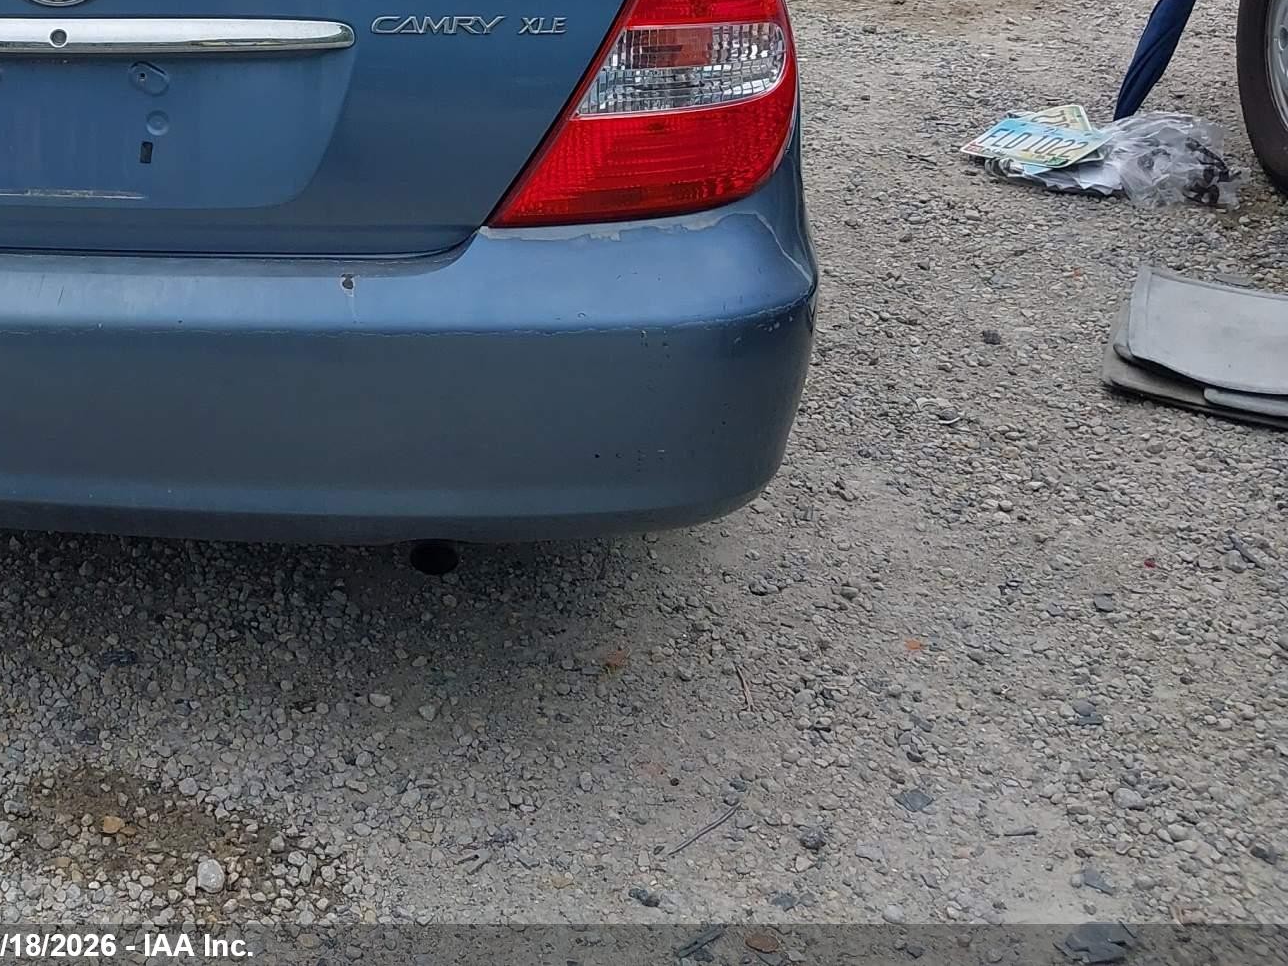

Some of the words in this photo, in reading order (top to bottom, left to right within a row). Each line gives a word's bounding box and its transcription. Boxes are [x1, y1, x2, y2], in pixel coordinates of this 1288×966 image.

[370, 15, 507, 35] CAMRY
[518, 16, 568, 35] XLE
[978, 128, 1033, 149] FLD
[1021, 134, 1089, 158] 1022
